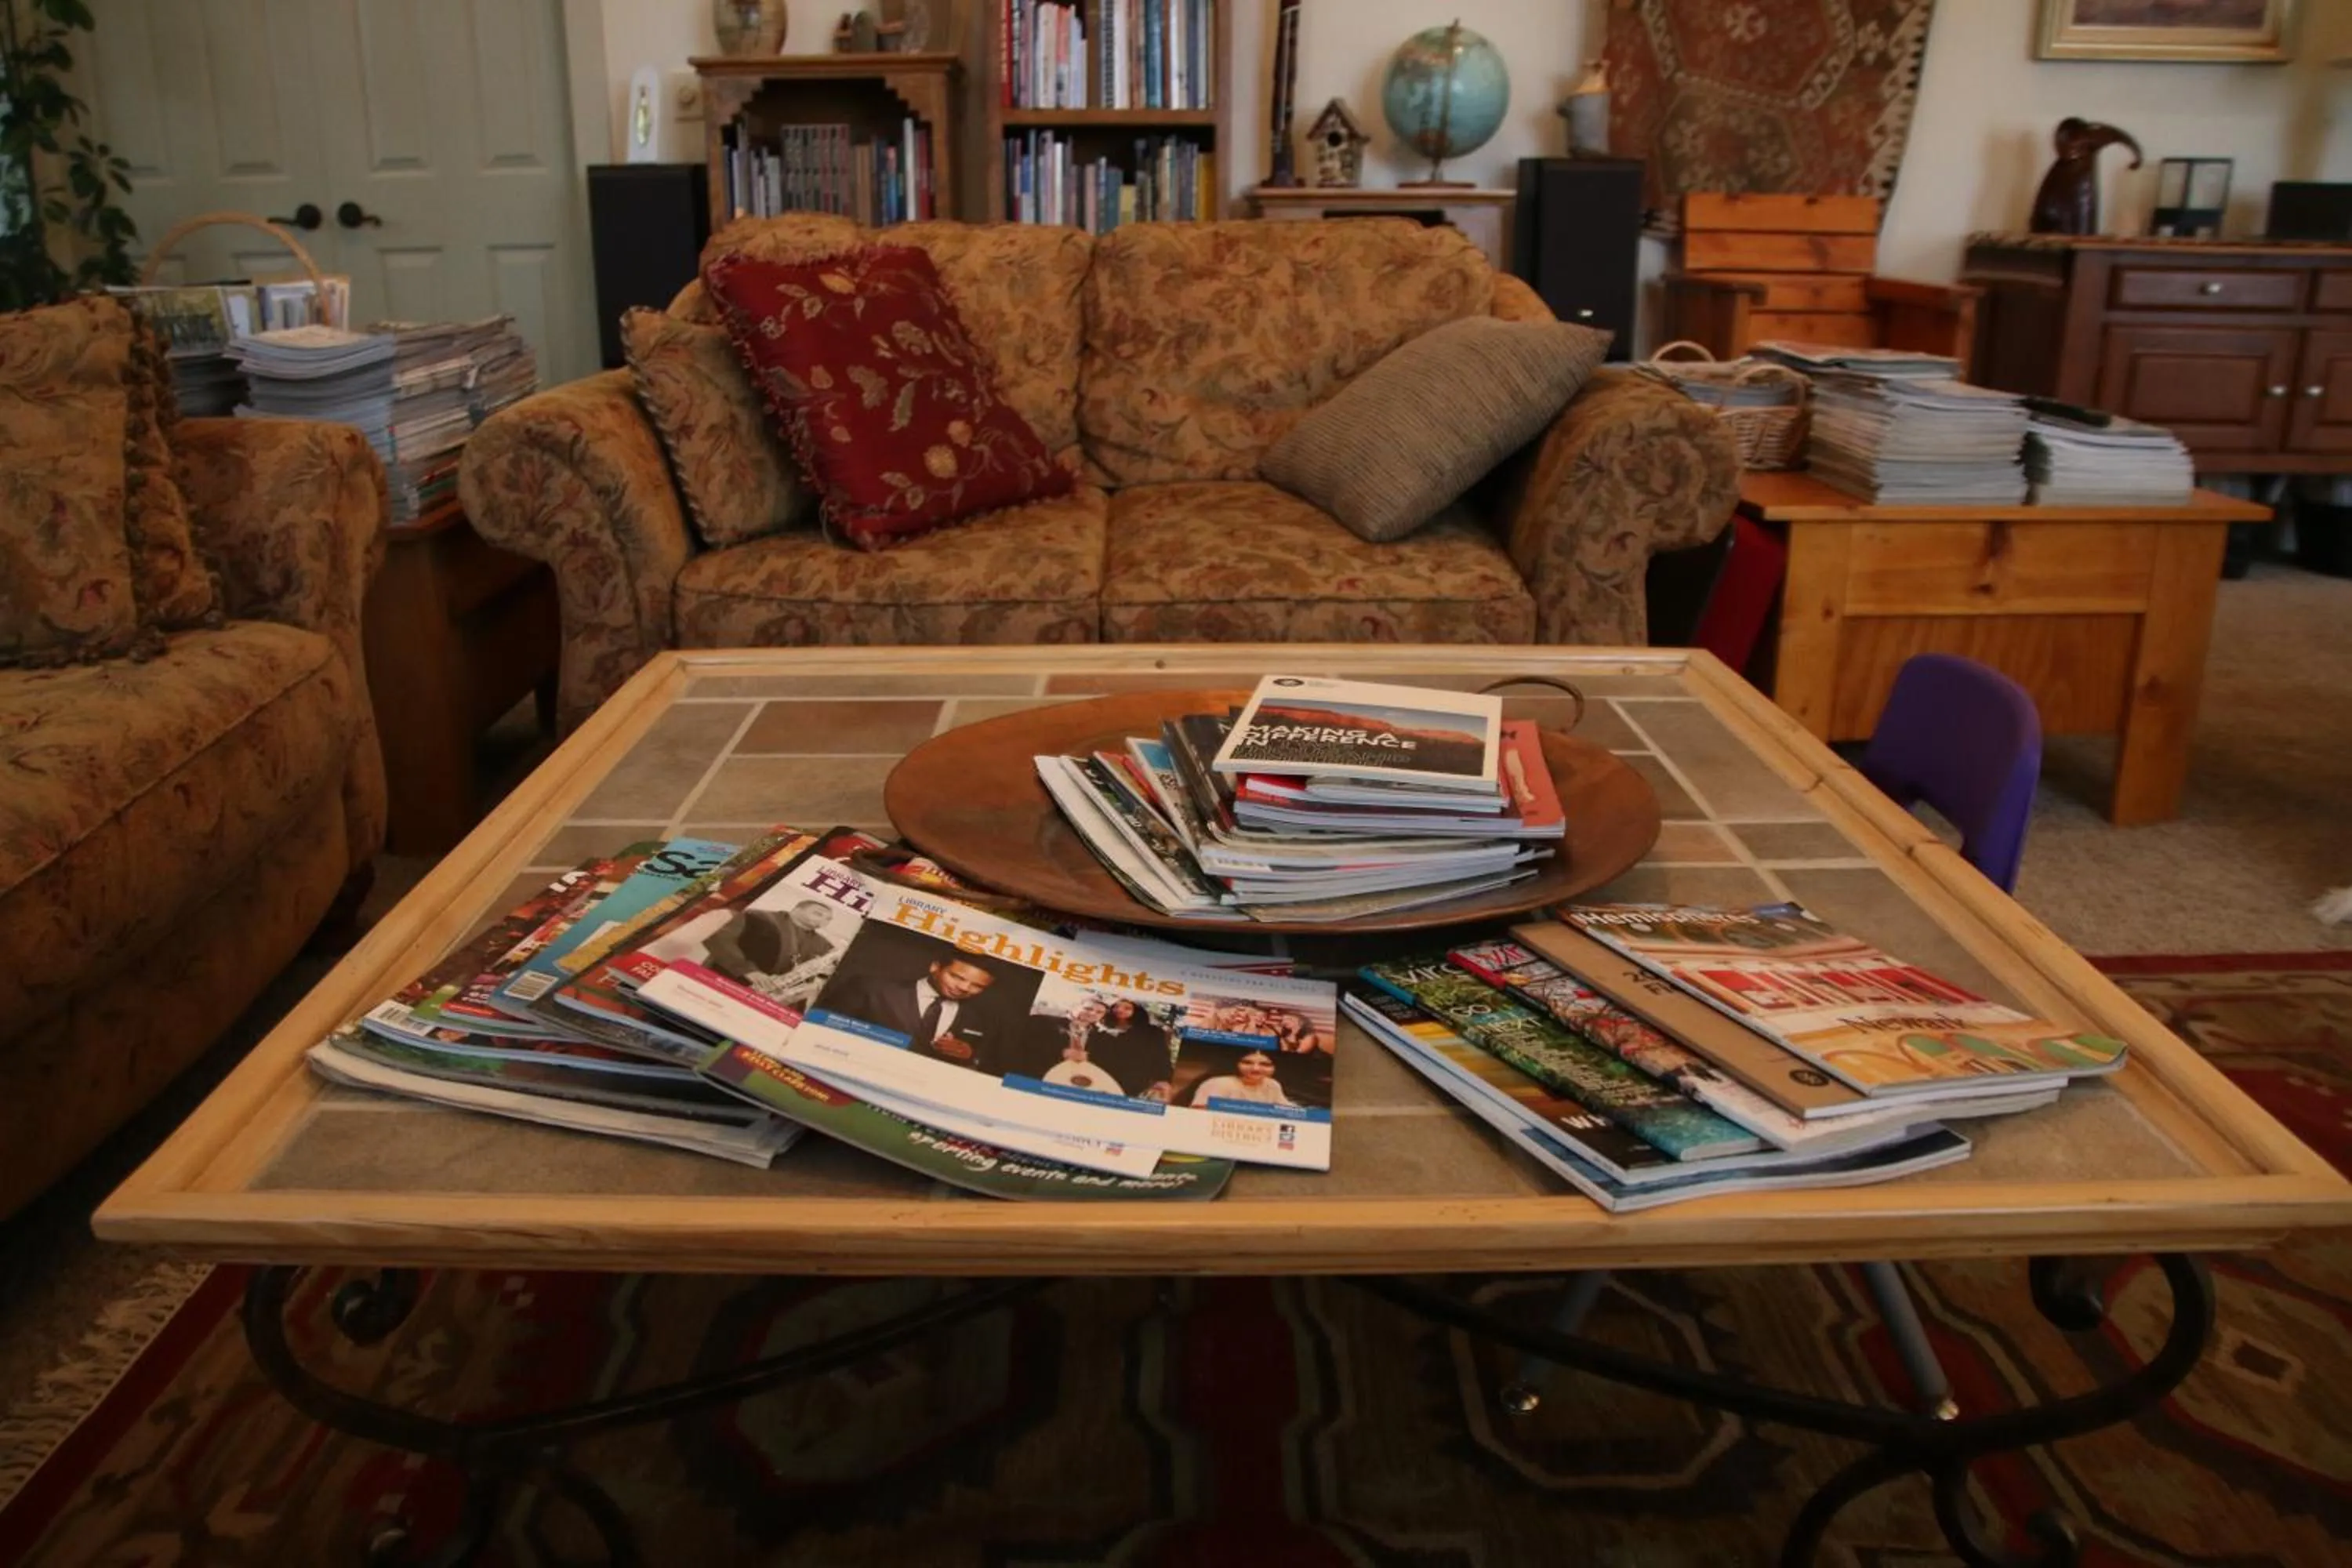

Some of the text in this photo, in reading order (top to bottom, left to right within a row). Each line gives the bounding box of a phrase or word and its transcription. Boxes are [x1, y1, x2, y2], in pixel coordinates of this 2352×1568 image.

[1243, 731, 1417, 750] DIFFERENCE
[1244, 724, 1368, 739] MAKING
[898, 895, 948, 914] LIBRARY
[889, 902, 1186, 996] Highlights
[907, 1131, 999, 1173] sporting
